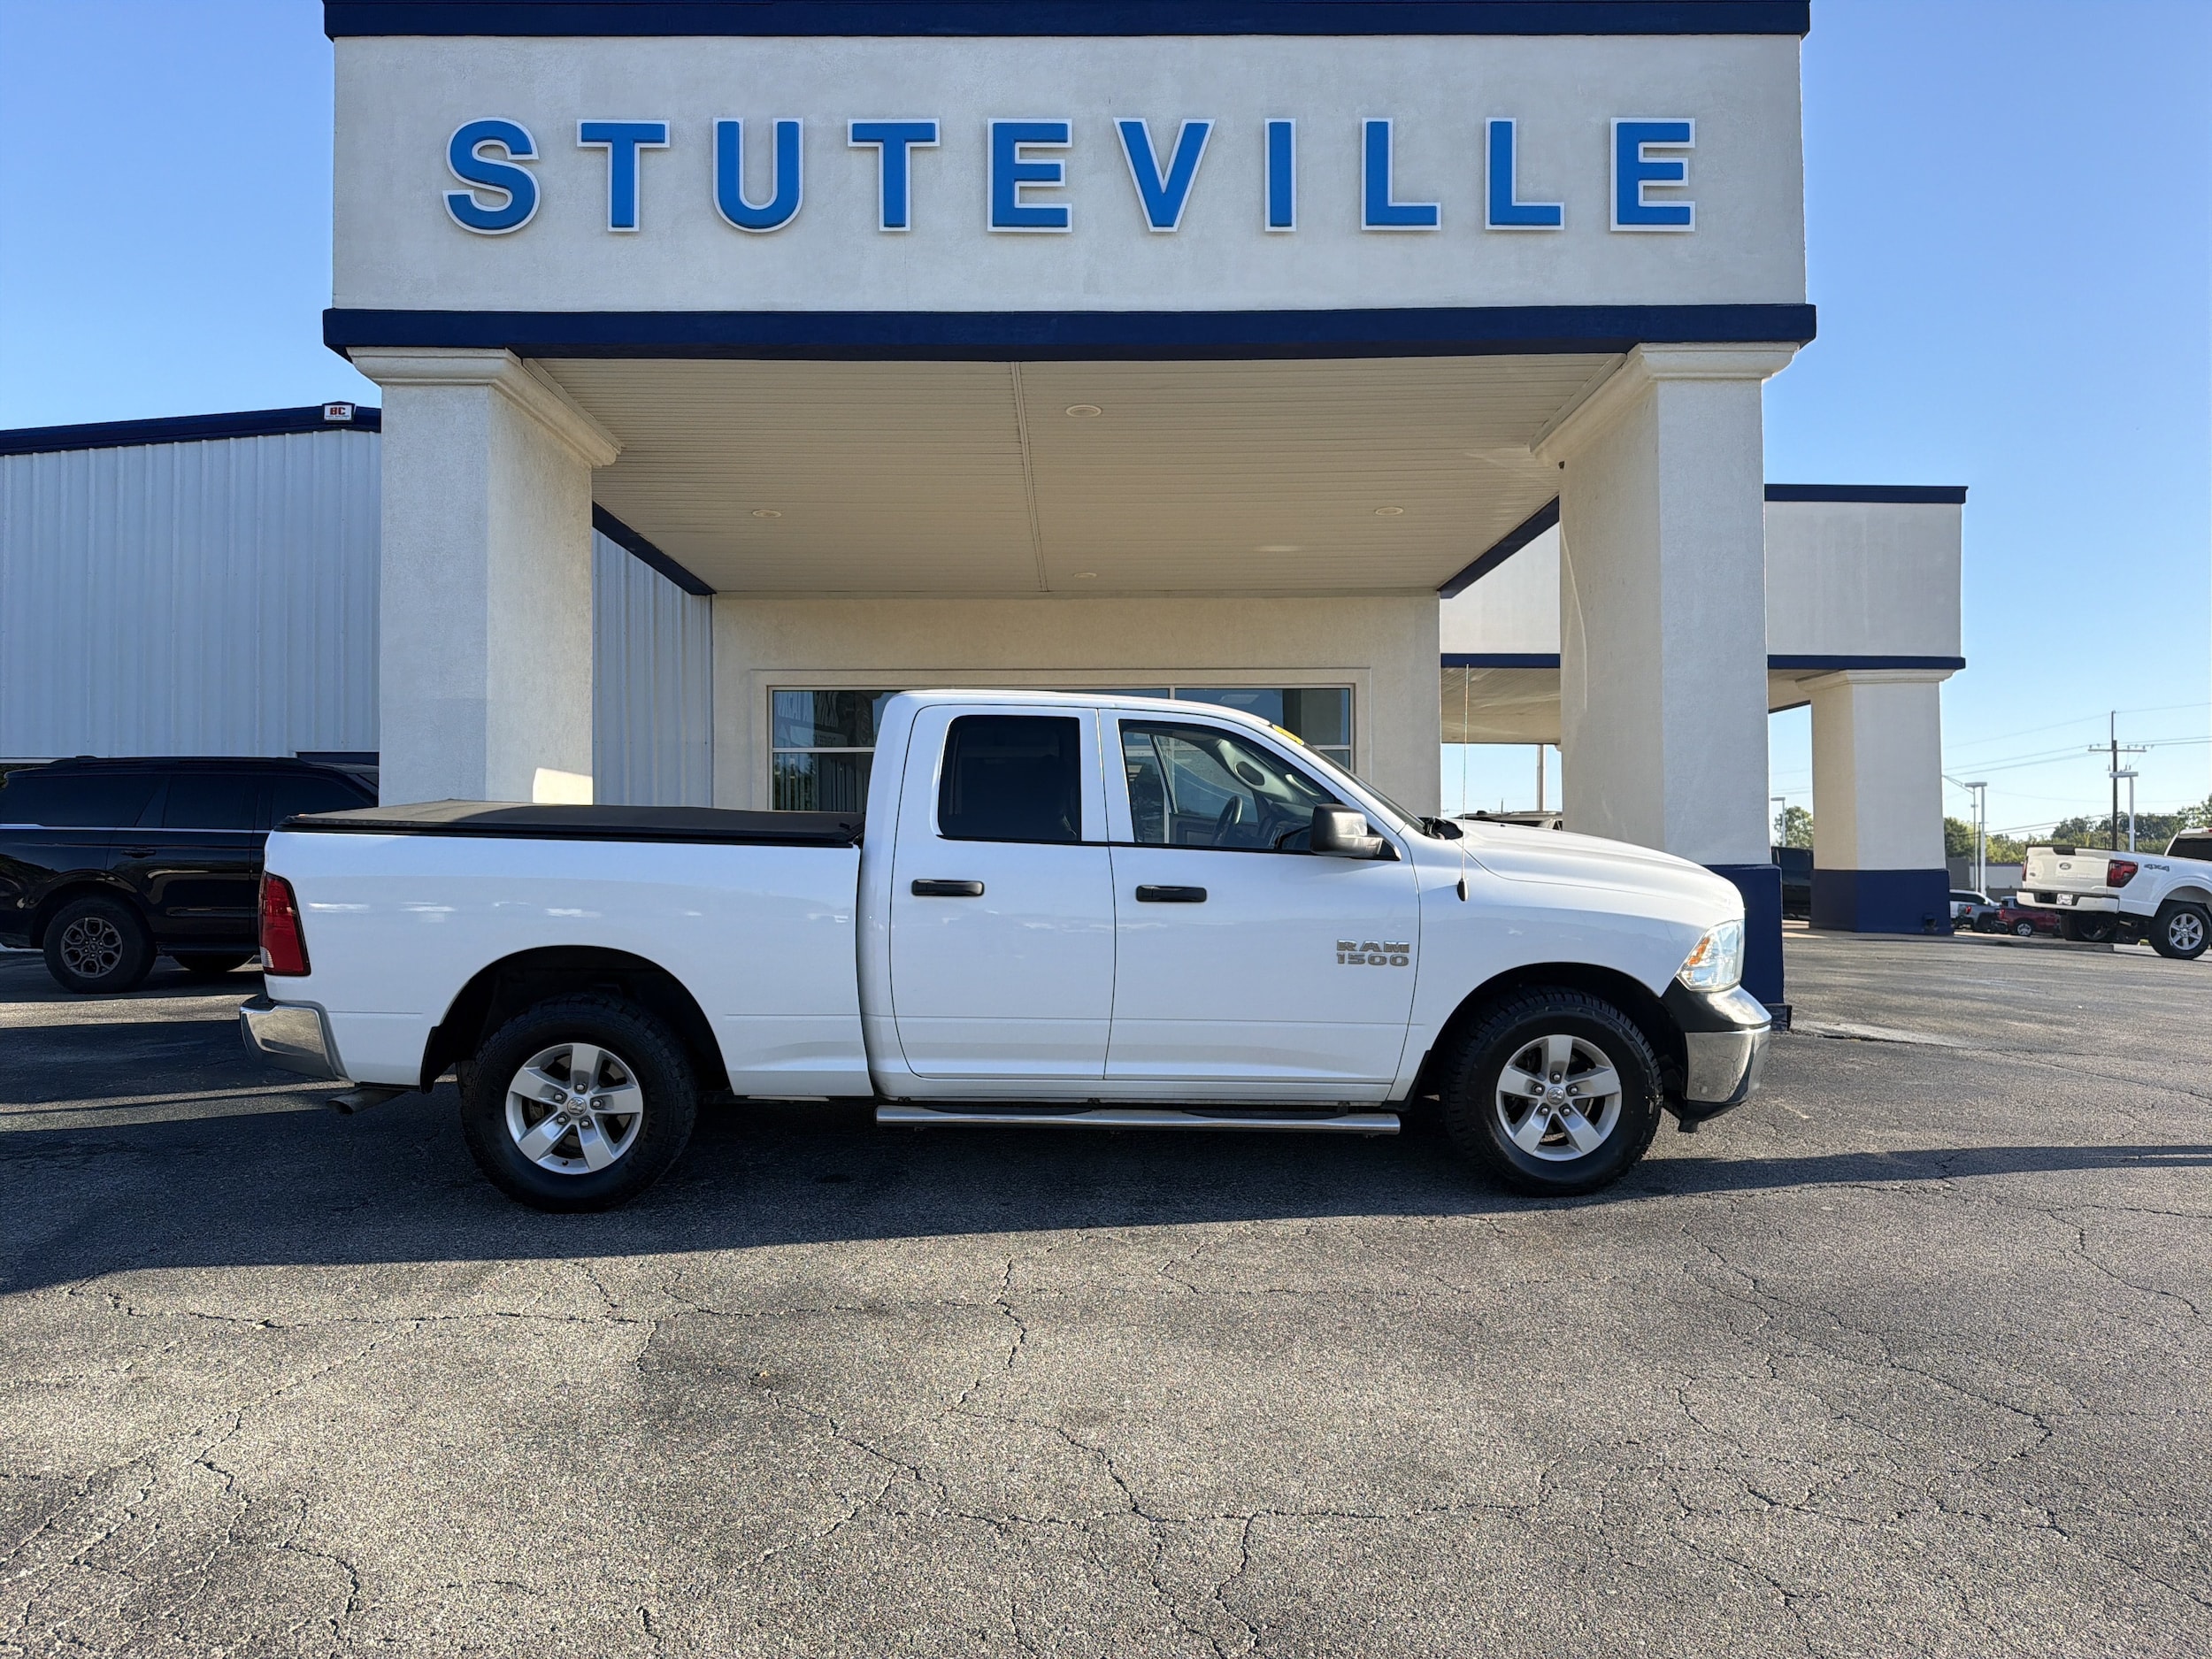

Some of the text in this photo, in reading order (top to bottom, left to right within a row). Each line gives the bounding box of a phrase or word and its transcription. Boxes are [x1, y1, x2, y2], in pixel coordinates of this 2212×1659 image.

[442, 116, 1696, 235] STUTEVILLE
[1336, 940, 1410, 953] RAM
[1336, 953, 1409, 966] 1500
